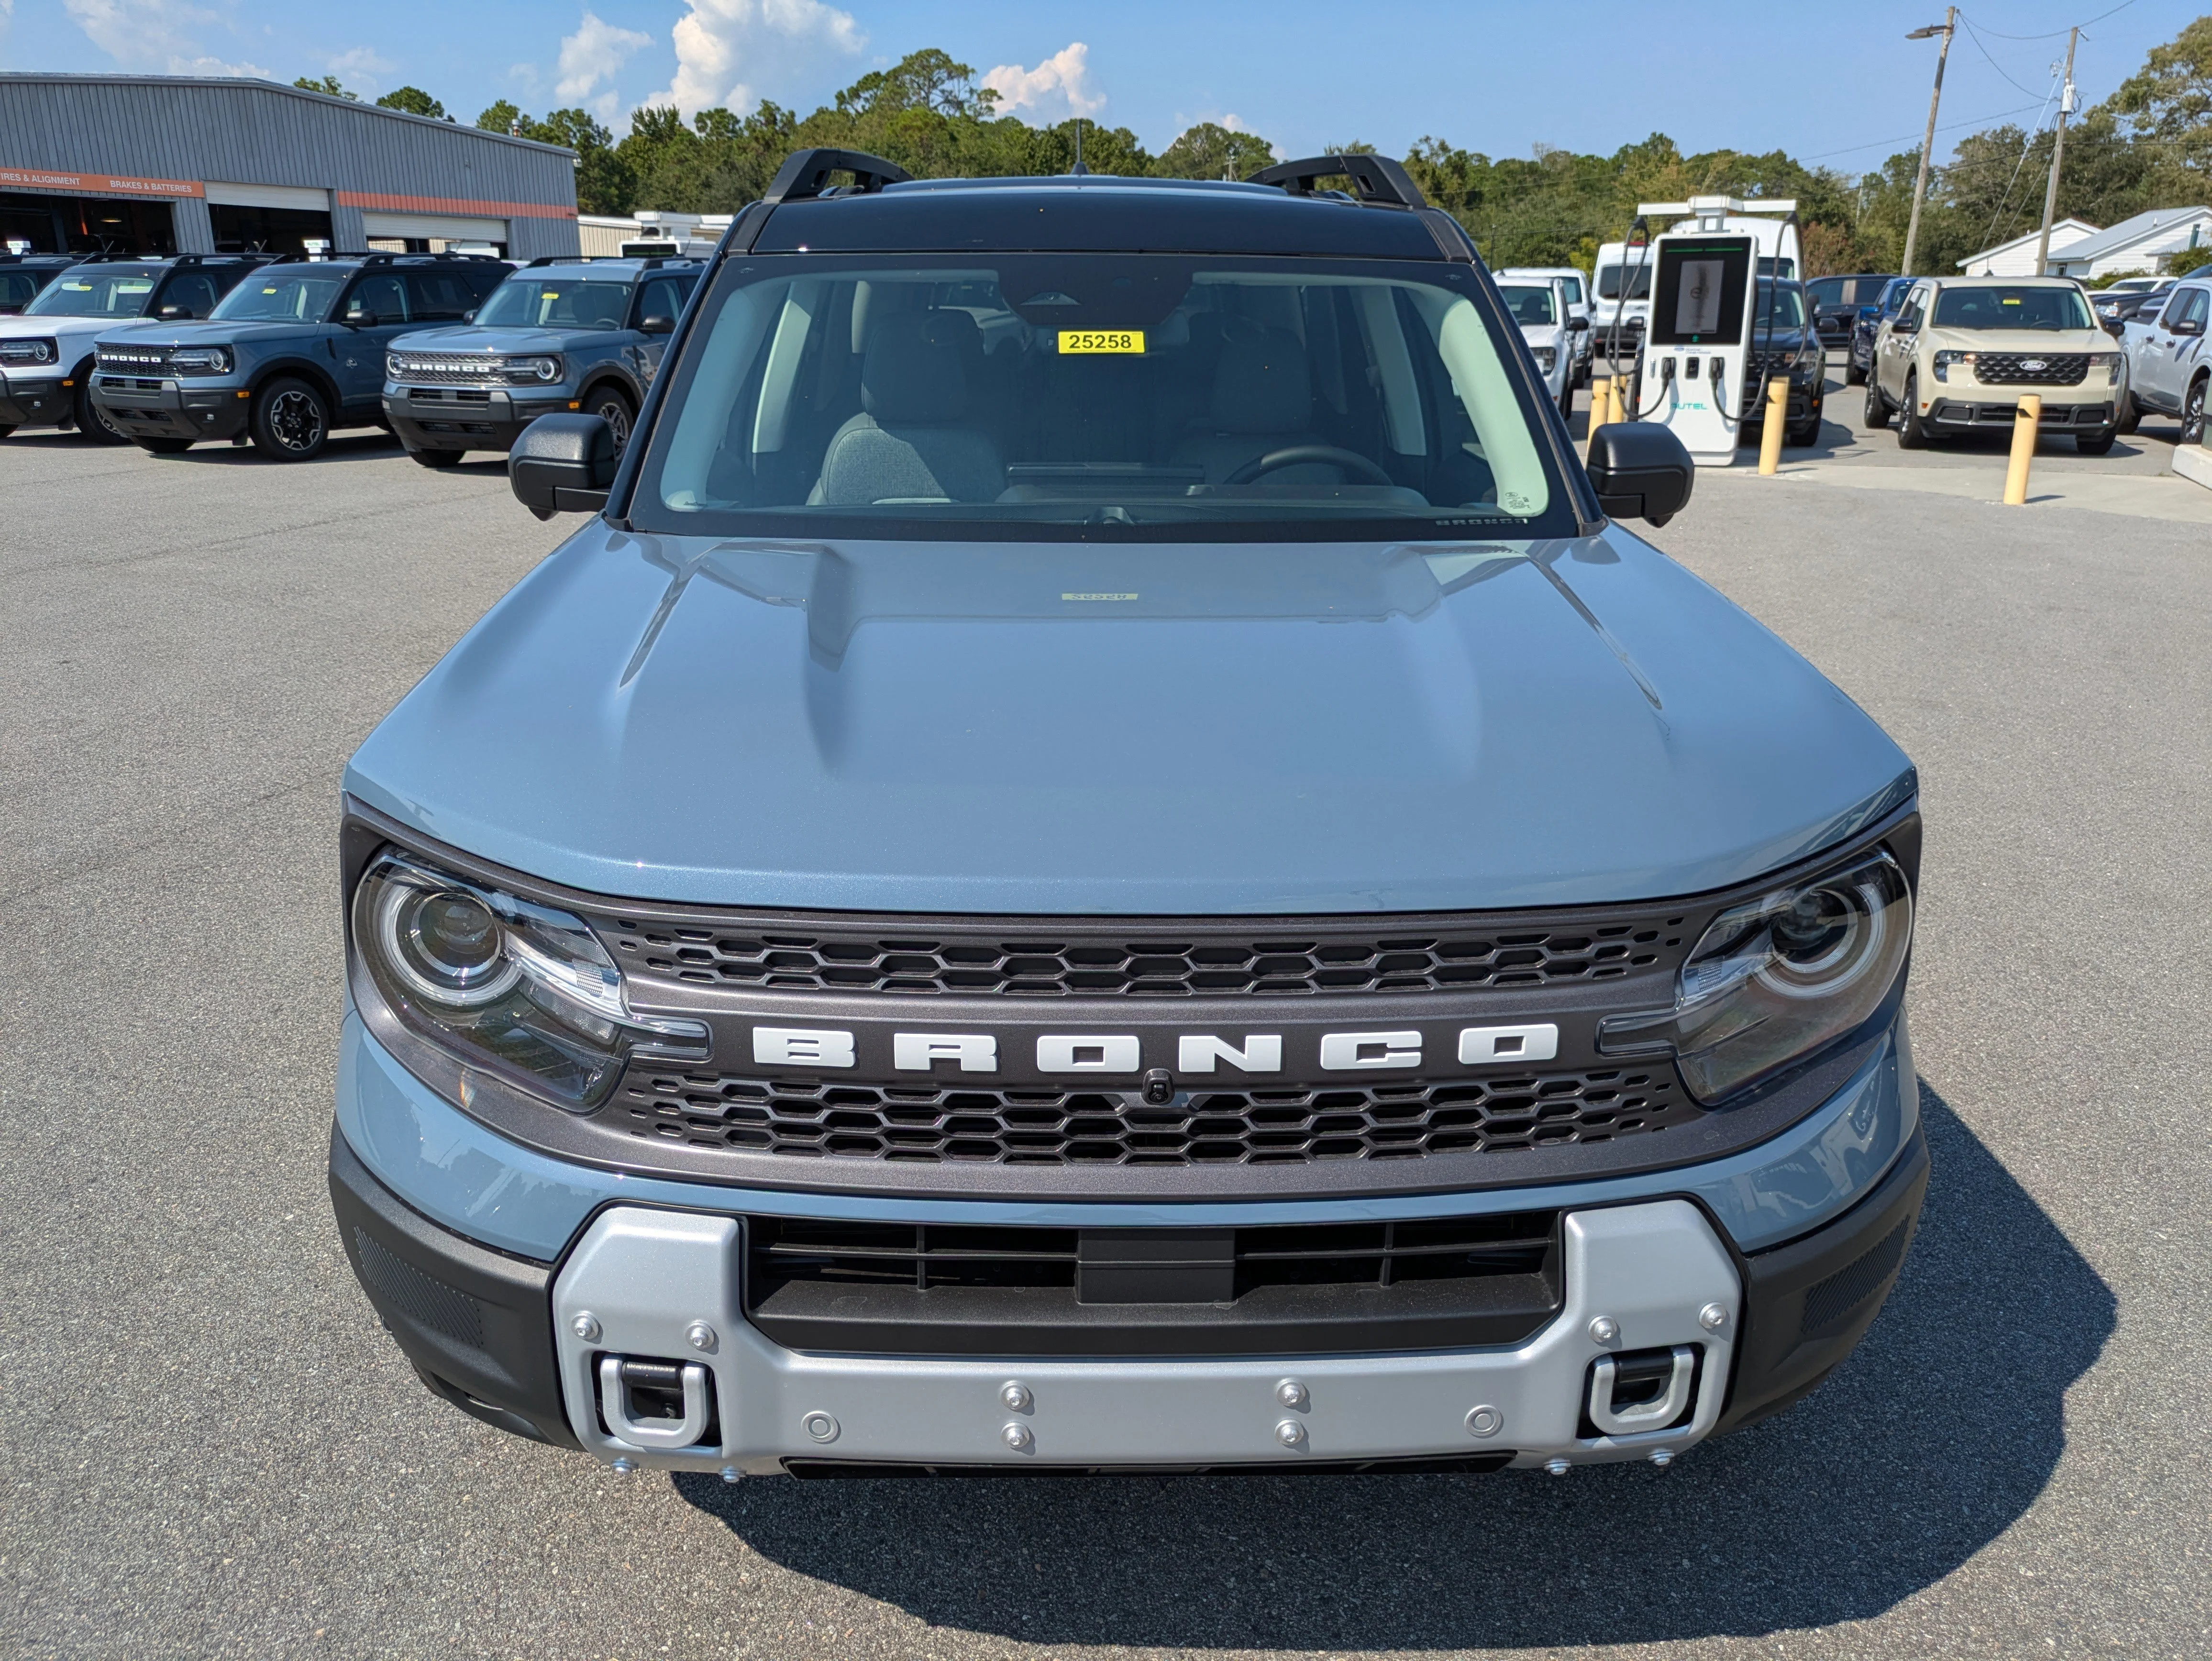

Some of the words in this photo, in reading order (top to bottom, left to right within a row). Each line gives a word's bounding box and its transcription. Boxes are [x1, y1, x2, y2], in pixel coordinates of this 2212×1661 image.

[0, 173, 21, 181] IRES
[32, 175, 80, 185] ALIGNMENT
[110, 180, 142, 189] BRAKES
[151, 183, 192, 192] BATTERIES
[1069, 334, 1132, 349] 25258
[101, 354, 161, 363] BRONCO
[409, 364, 490, 372] BRONCO
[752, 1023, 1558, 1072] BRONCO
